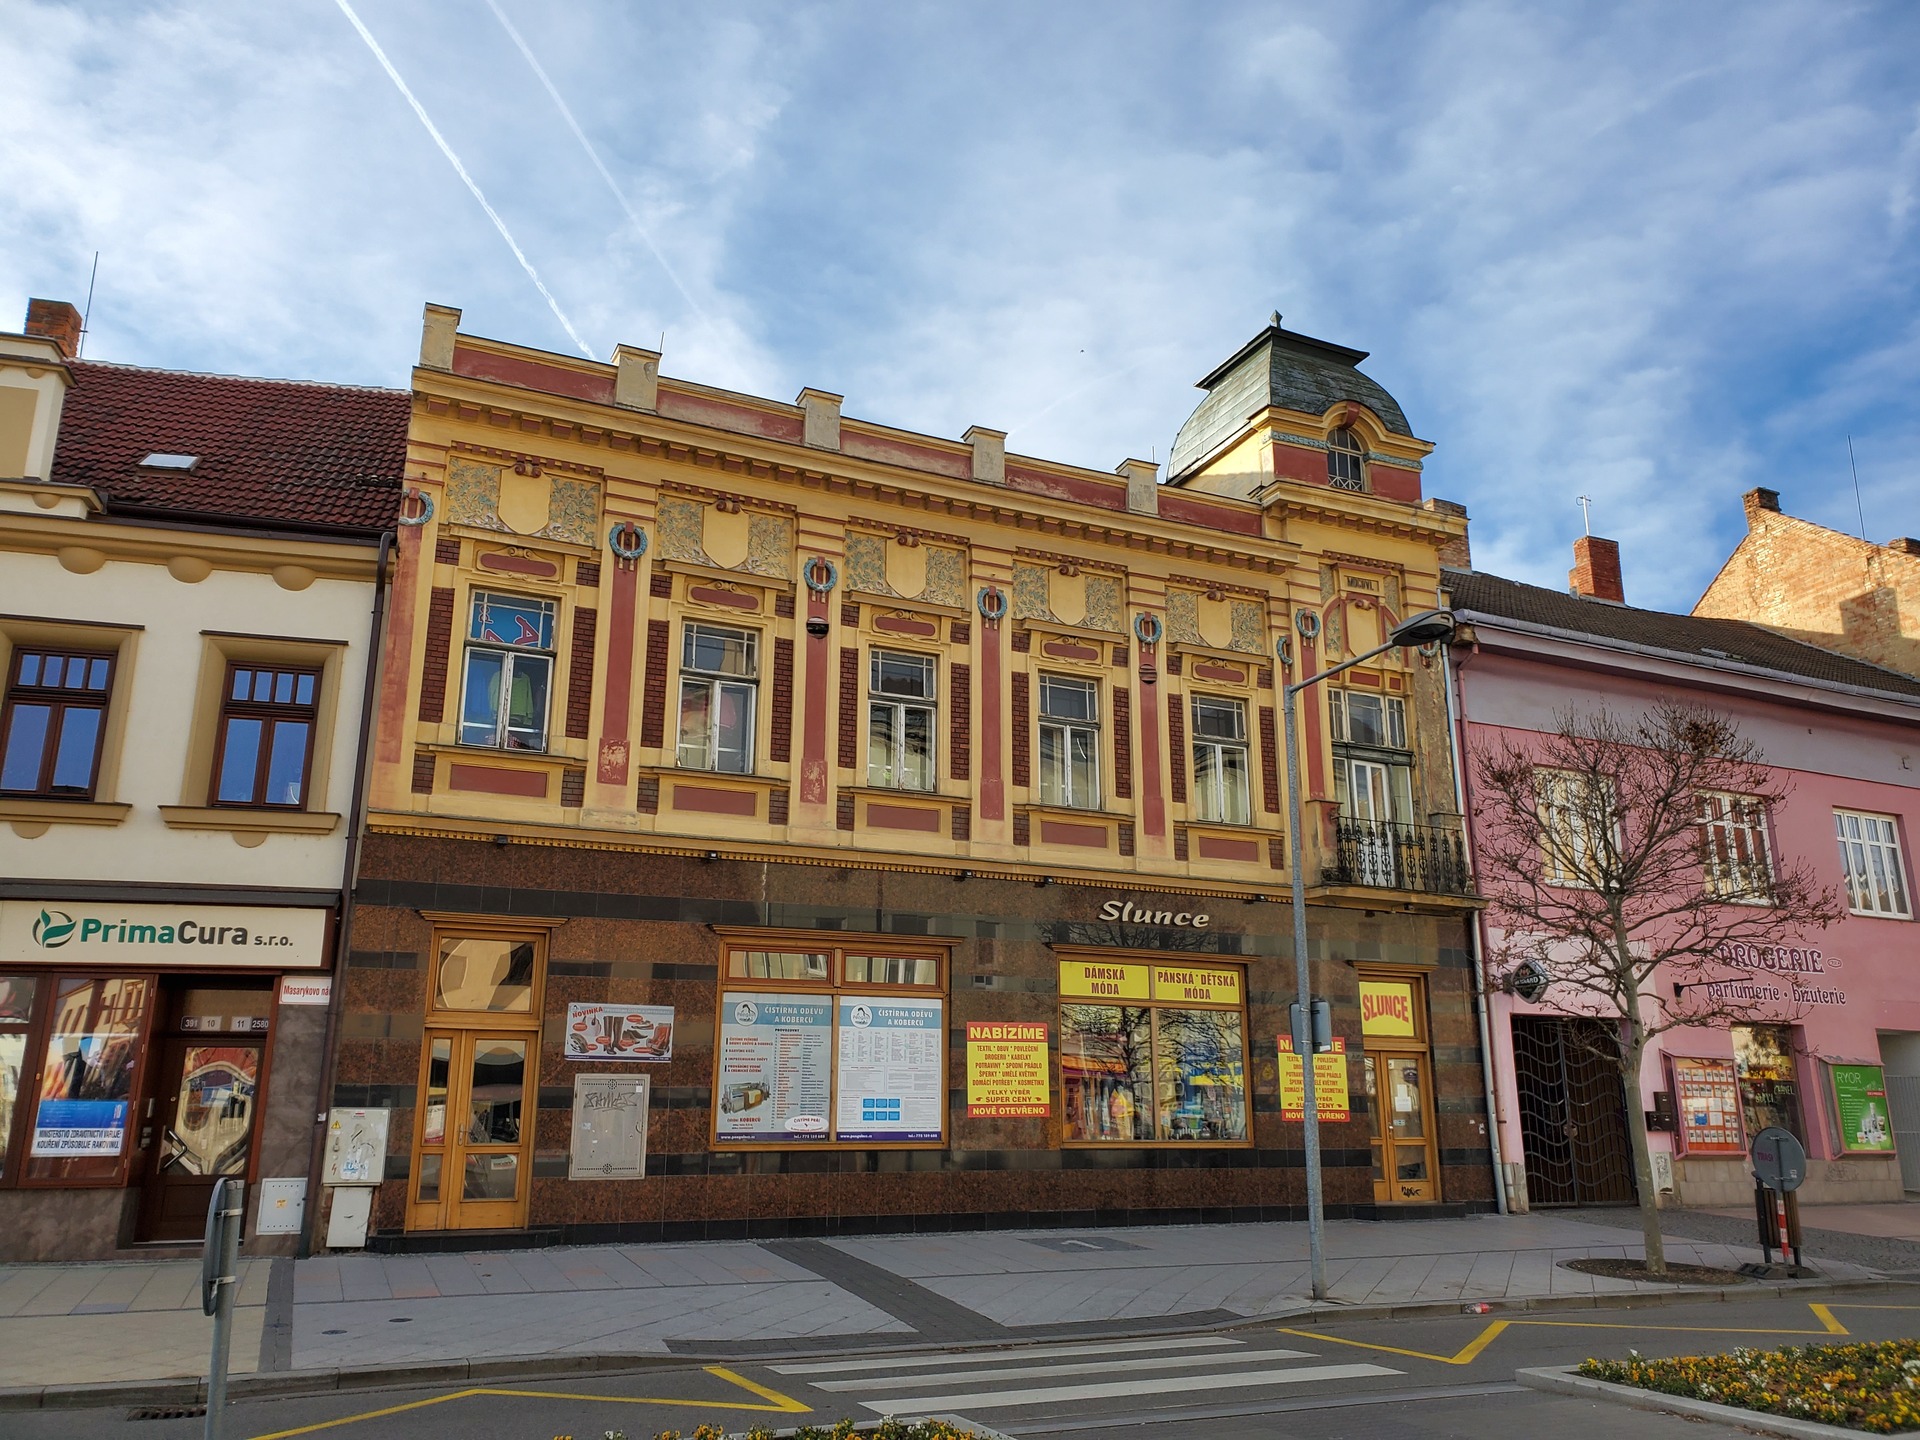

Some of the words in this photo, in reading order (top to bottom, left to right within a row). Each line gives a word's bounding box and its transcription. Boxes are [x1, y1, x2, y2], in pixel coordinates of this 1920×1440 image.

[1098, 900, 1210, 928] Slunce
[80, 918, 248, 946] PrimaCura
[253, 933, 294, 947] s.r.o.
[1719, 943, 1824, 973] DROGERIE
[1084, 965, 1126, 981] DÁMSKÁ
[1157, 969, 1195, 985] PÁNSKÁ
[1200, 972, 1236, 988] DĚTSKÁ
[283, 985, 320, 997] Masarykovo
[1091, 981, 1120, 995] MÓDA
[1184, 985, 1211, 1000] MÓDA
[1707, 982, 1780, 1001] parfumerie
[572, 1006, 604, 1019] NOVINKA
[1362, 993, 1410, 1023] SLUNCE
[207, 1019, 216, 1027] 10
[237, 1020, 245, 1028] 11
[969, 1025, 1045, 1040] NABÍZÍME
[1836, 1071, 1862, 1084] RYOR
[972, 1106, 997, 1115] NOVĚ
[999, 1106, 1045, 1115] OTEVŘENO
[1317, 1111, 1346, 1119] EVŘENO
[39, 1129, 70, 1138] MINISTERSTVO
[37, 1139, 60, 1149] KOUŘENÍ
[60, 1139, 91, 1149] ZPŮSOBUJE
